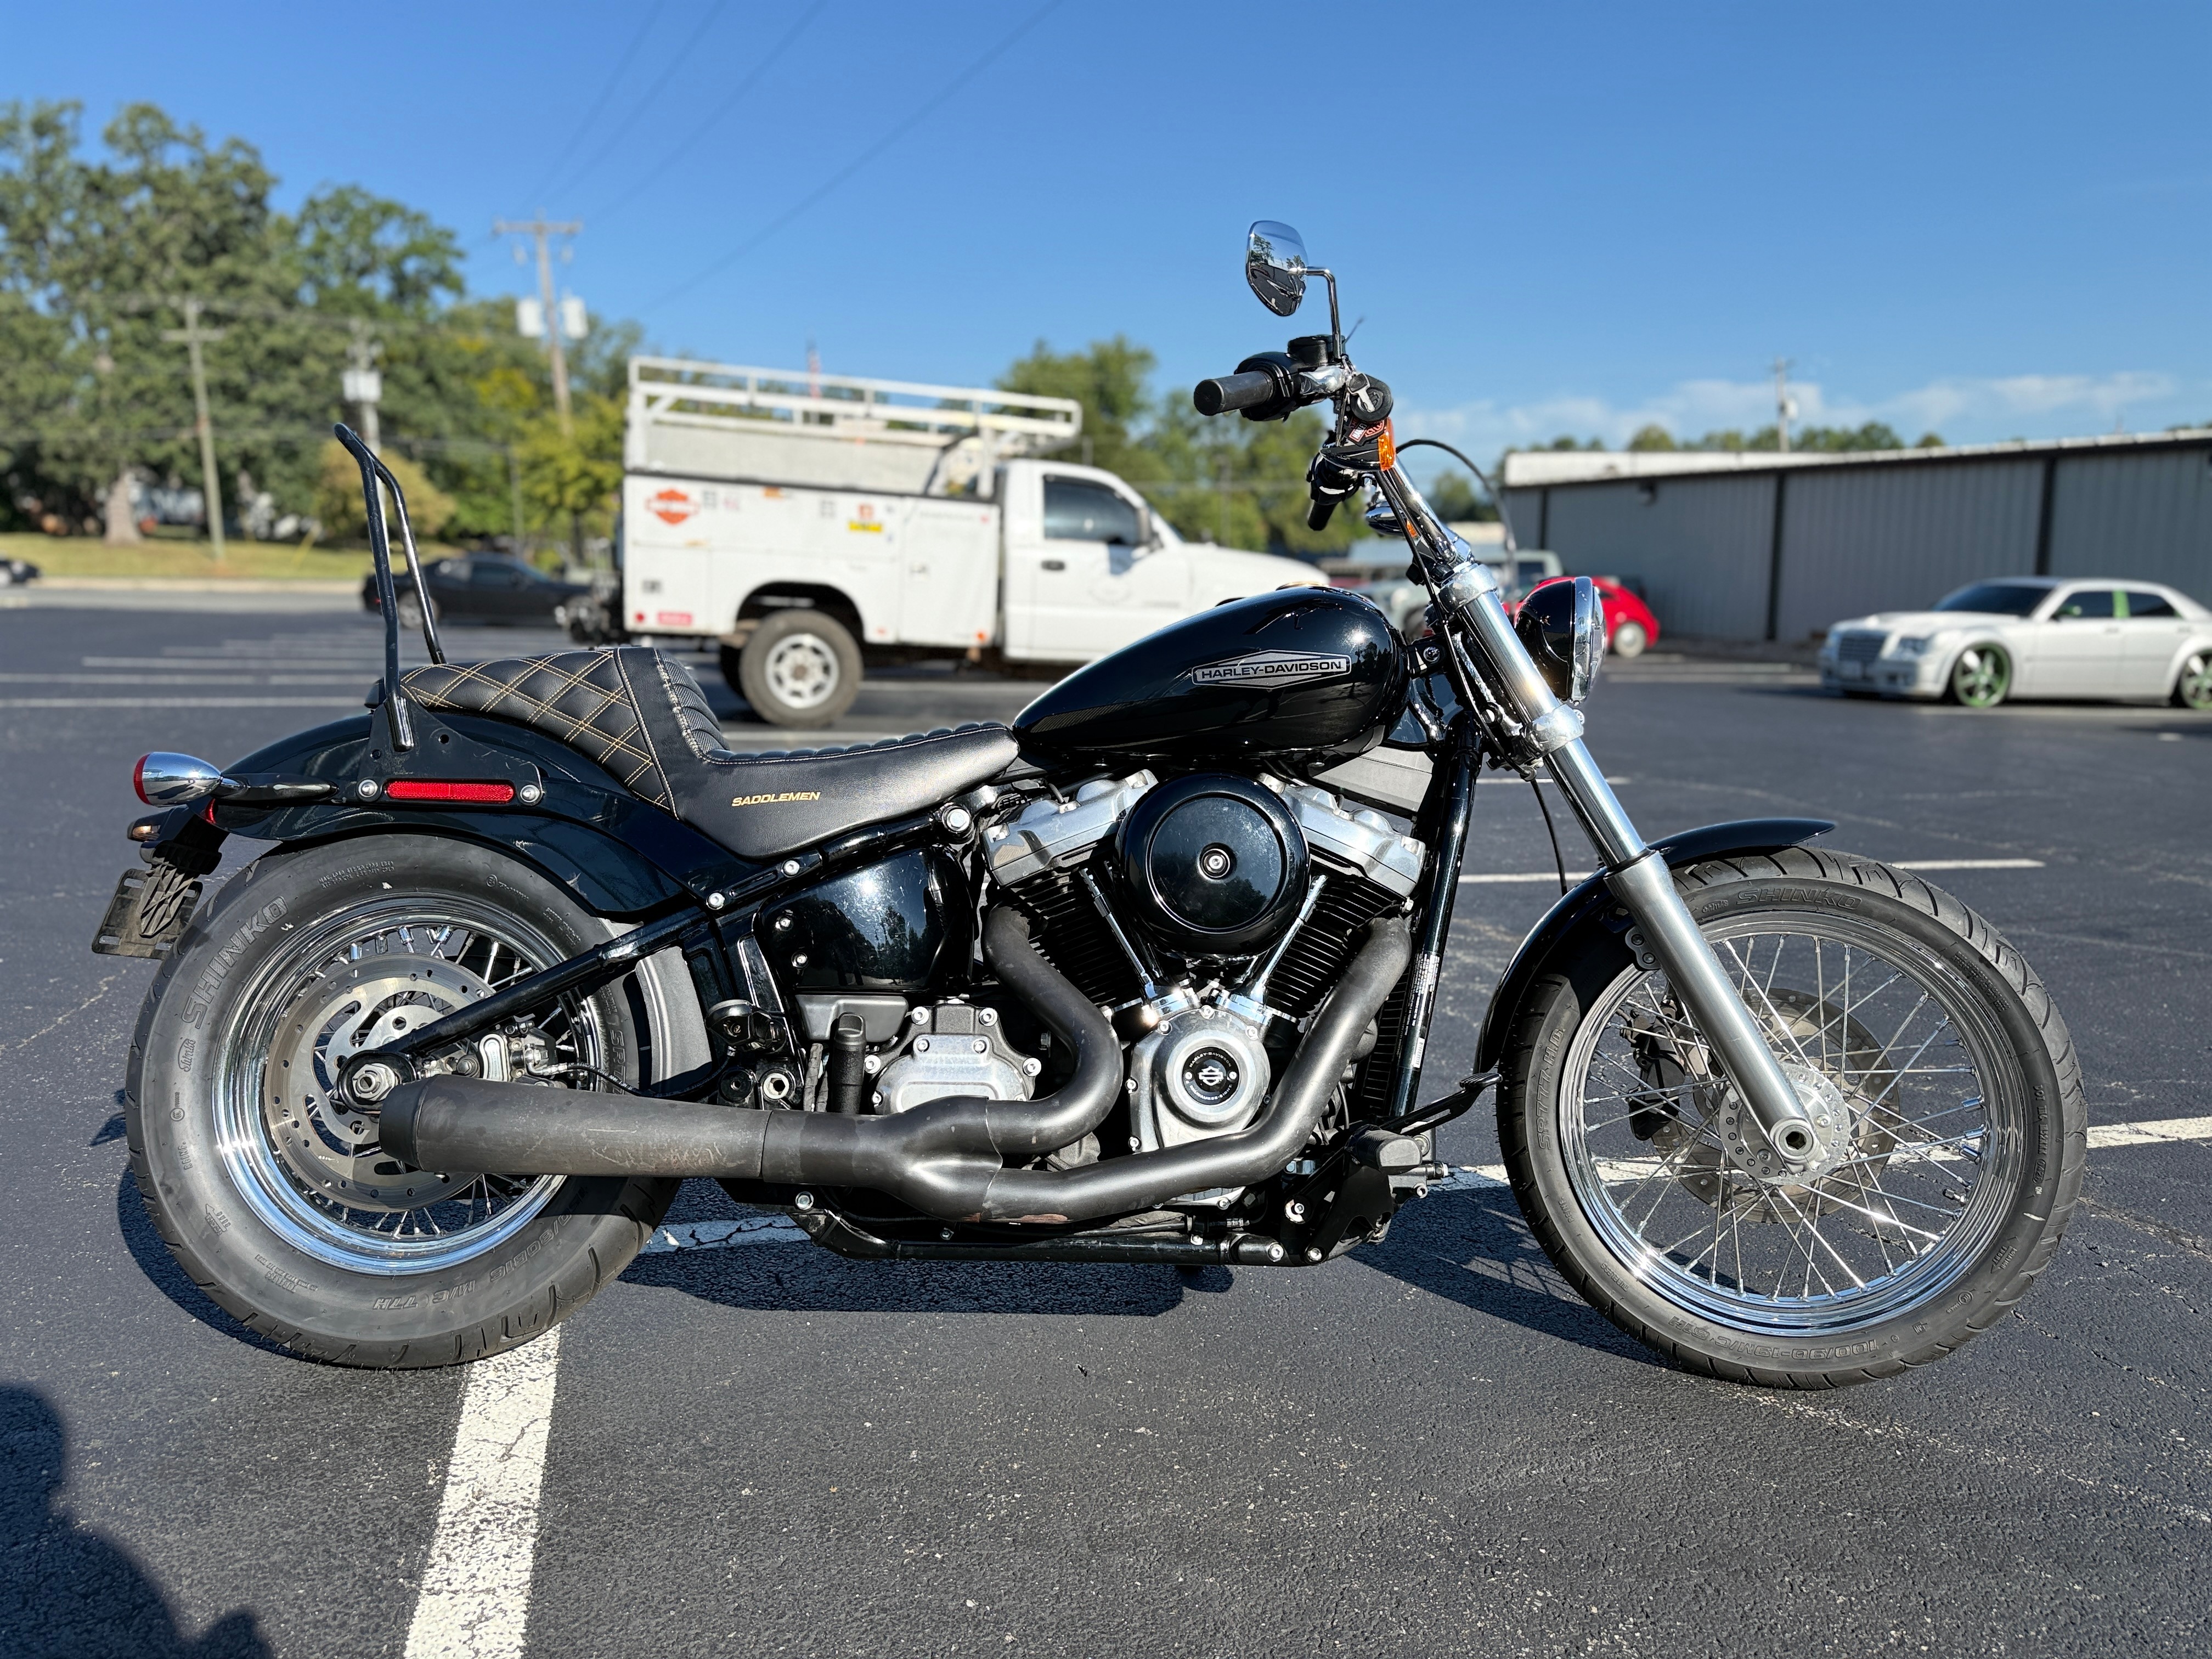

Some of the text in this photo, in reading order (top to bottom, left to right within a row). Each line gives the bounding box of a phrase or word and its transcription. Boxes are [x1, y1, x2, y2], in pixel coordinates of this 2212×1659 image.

[1201, 661, 1341, 679] HARLEY-DAVIDSON
[731, 792, 821, 807] SADDLEMEN
[1736, 888, 1863, 910] SHINKO
[182, 895, 289, 1029] SHINKO
[1537, 1028, 1566, 1152] SR777 H.D.
[2033, 1084, 2045, 1101] DOT
[433, 1279, 476, 1304] M/C
[372, 1296, 421, 1311] 77H
